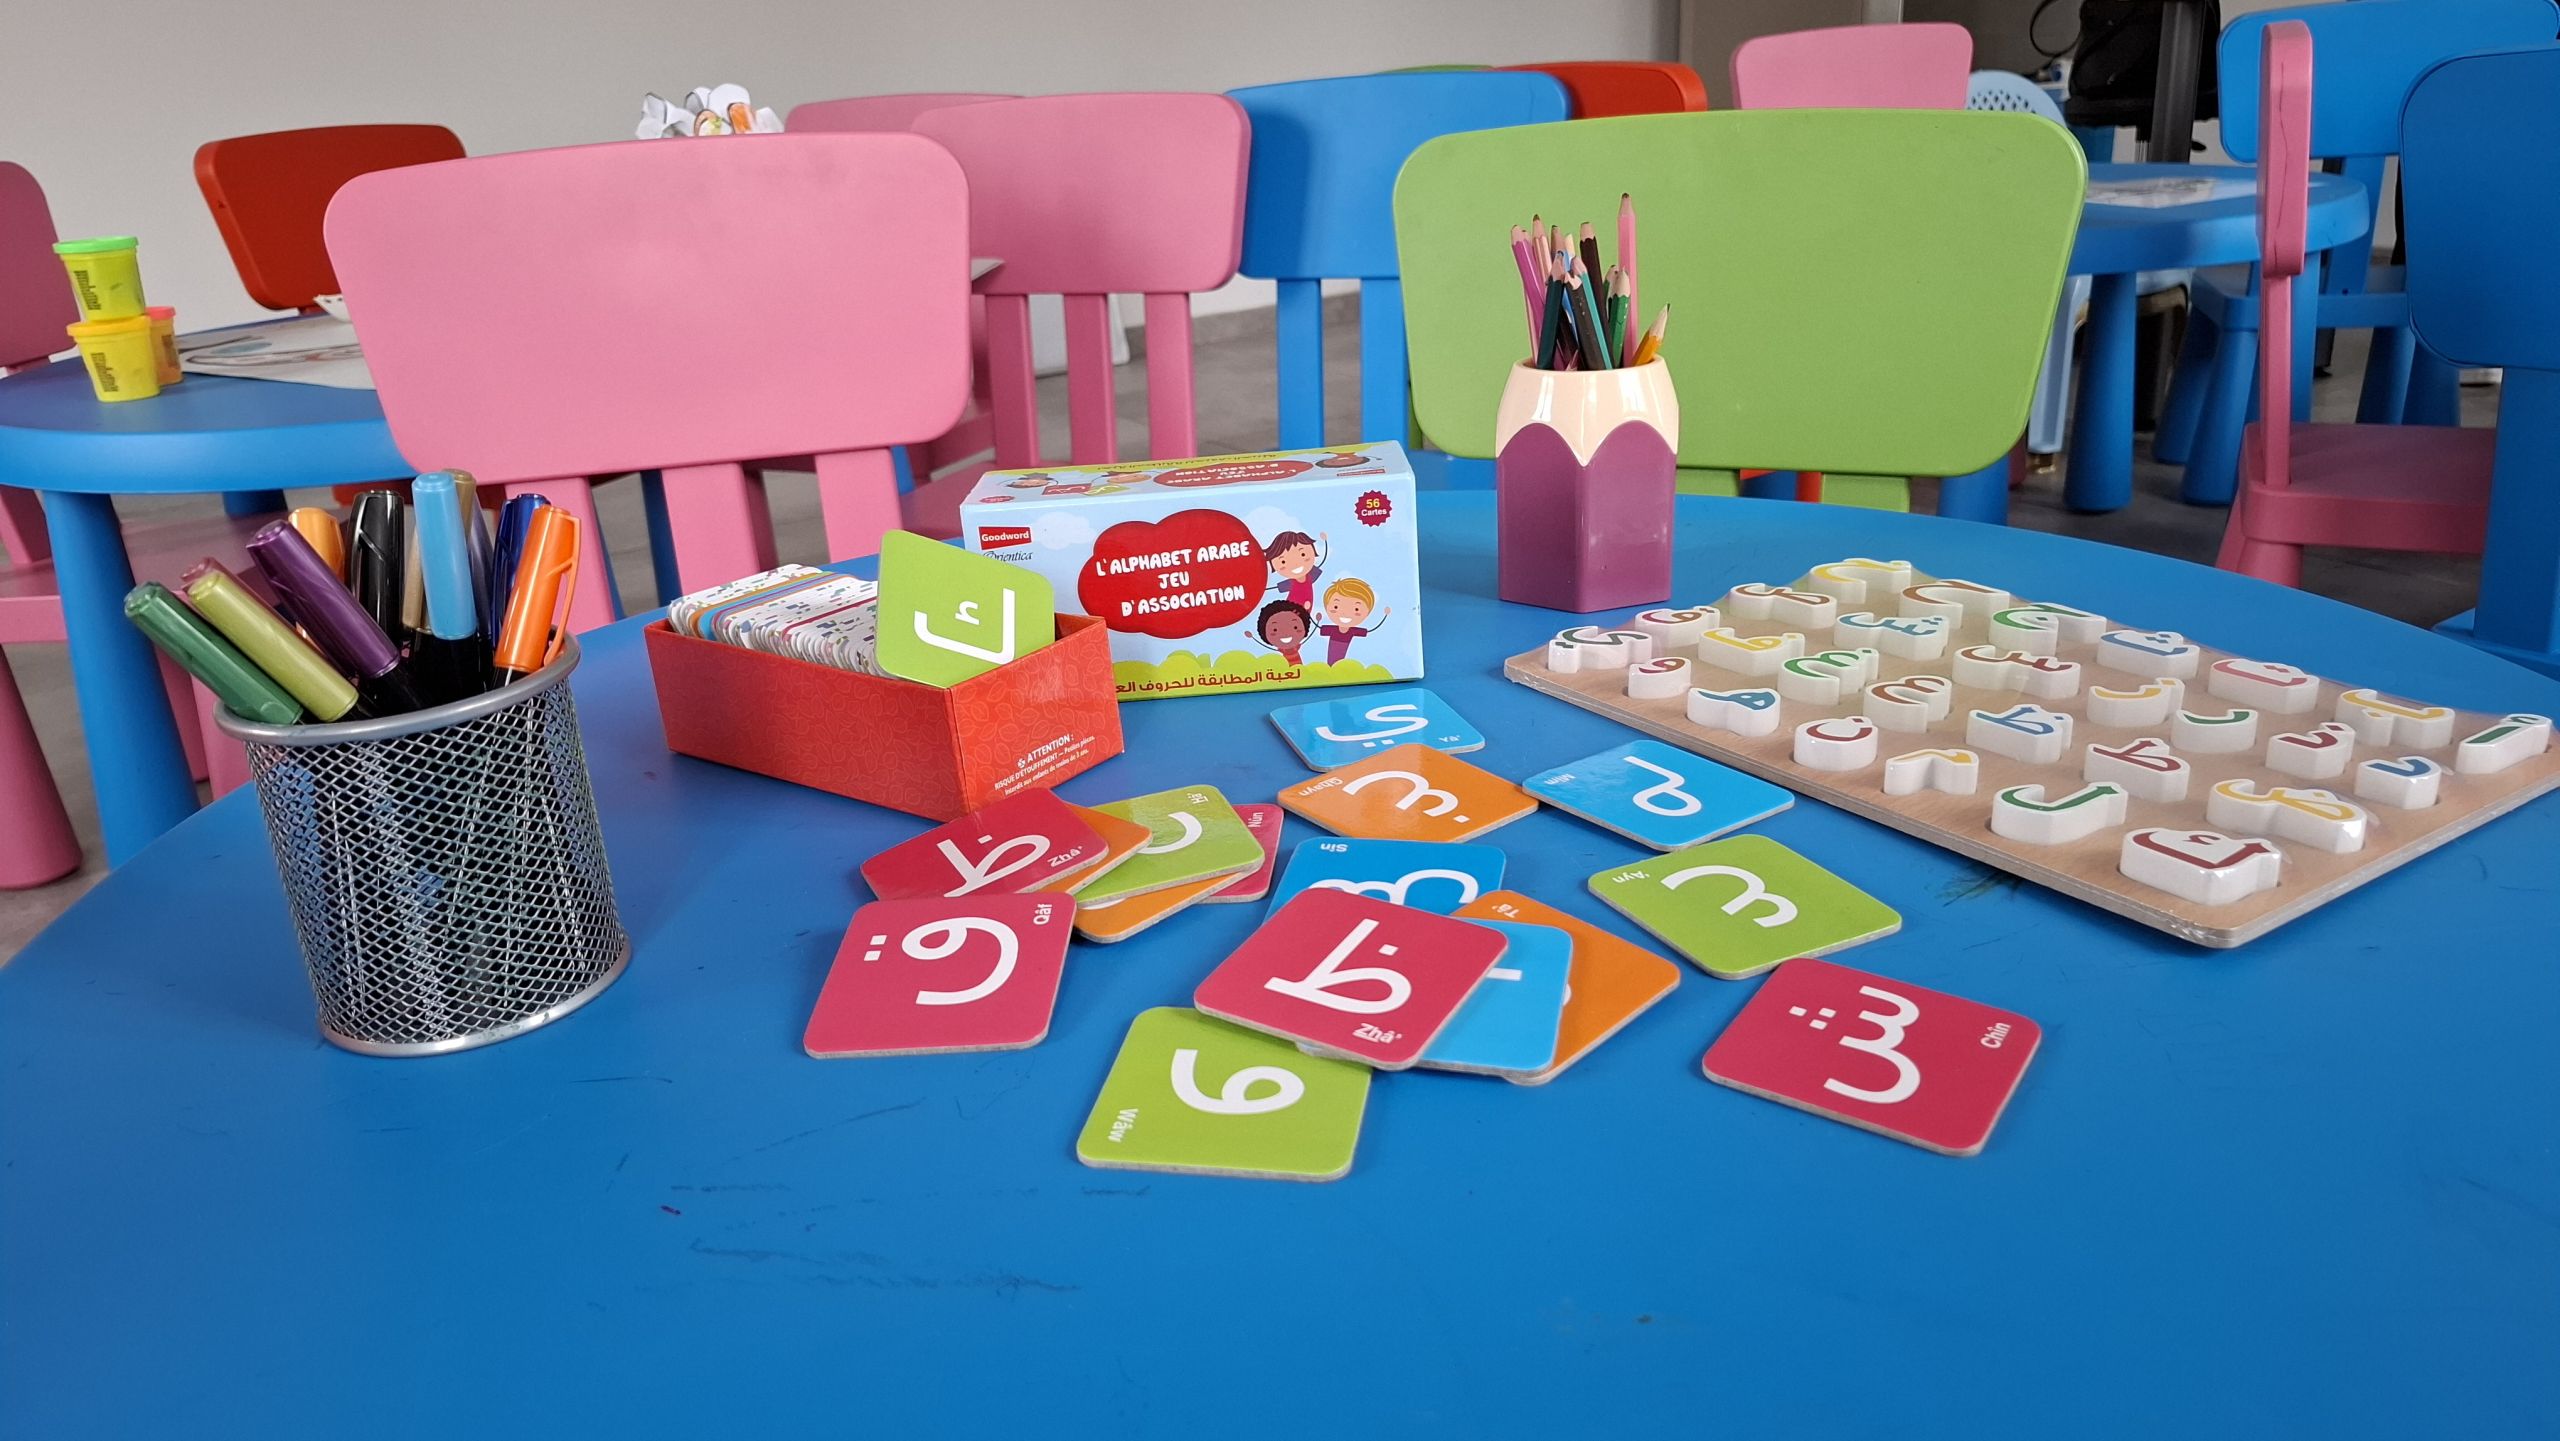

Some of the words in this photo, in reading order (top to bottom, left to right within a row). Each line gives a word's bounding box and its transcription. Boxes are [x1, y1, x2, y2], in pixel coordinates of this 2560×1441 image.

[1361, 507, 1388, 518] Cartes
[1365, 498, 1381, 508] 56
[981, 531, 1030, 542] Goodword
[1096, 548, 1192, 577] L'ALPHABET
[1197, 540, 1250, 563] ARABE
[1157, 571, 1190, 589] JEU
[1121, 585, 1246, 617] D'ASSOCIATION
[1139, 677, 1195, 692] للحروف
[1197, 672, 1263, 687] المطابقة
[1265, 668, 1301, 683] لعبة
[1027, 733, 1070, 763] ATTENTION
[994, 776, 1015, 790] RISQUE
[1298, 776, 1344, 796] Ghayn
[1342, 769, 1471, 824] غ
[1624, 755, 1702, 817] م
[2001, 785, 2119, 812] ل
[2216, 781, 2355, 821] ض
[936, 834, 1050, 898] ظ
[1660, 864, 1798, 929] ع
[1033, 903, 1053, 925] Qâf
[863, 916, 1019, 1006] ق
[1263, 917, 1412, 1014] ظ
[1788, 985, 1921, 1104] ش
[1979, 1022, 2012, 1049] Chîn
[1170, 1048, 1305, 1114] و
[1107, 1108, 1139, 1143] Wâw
